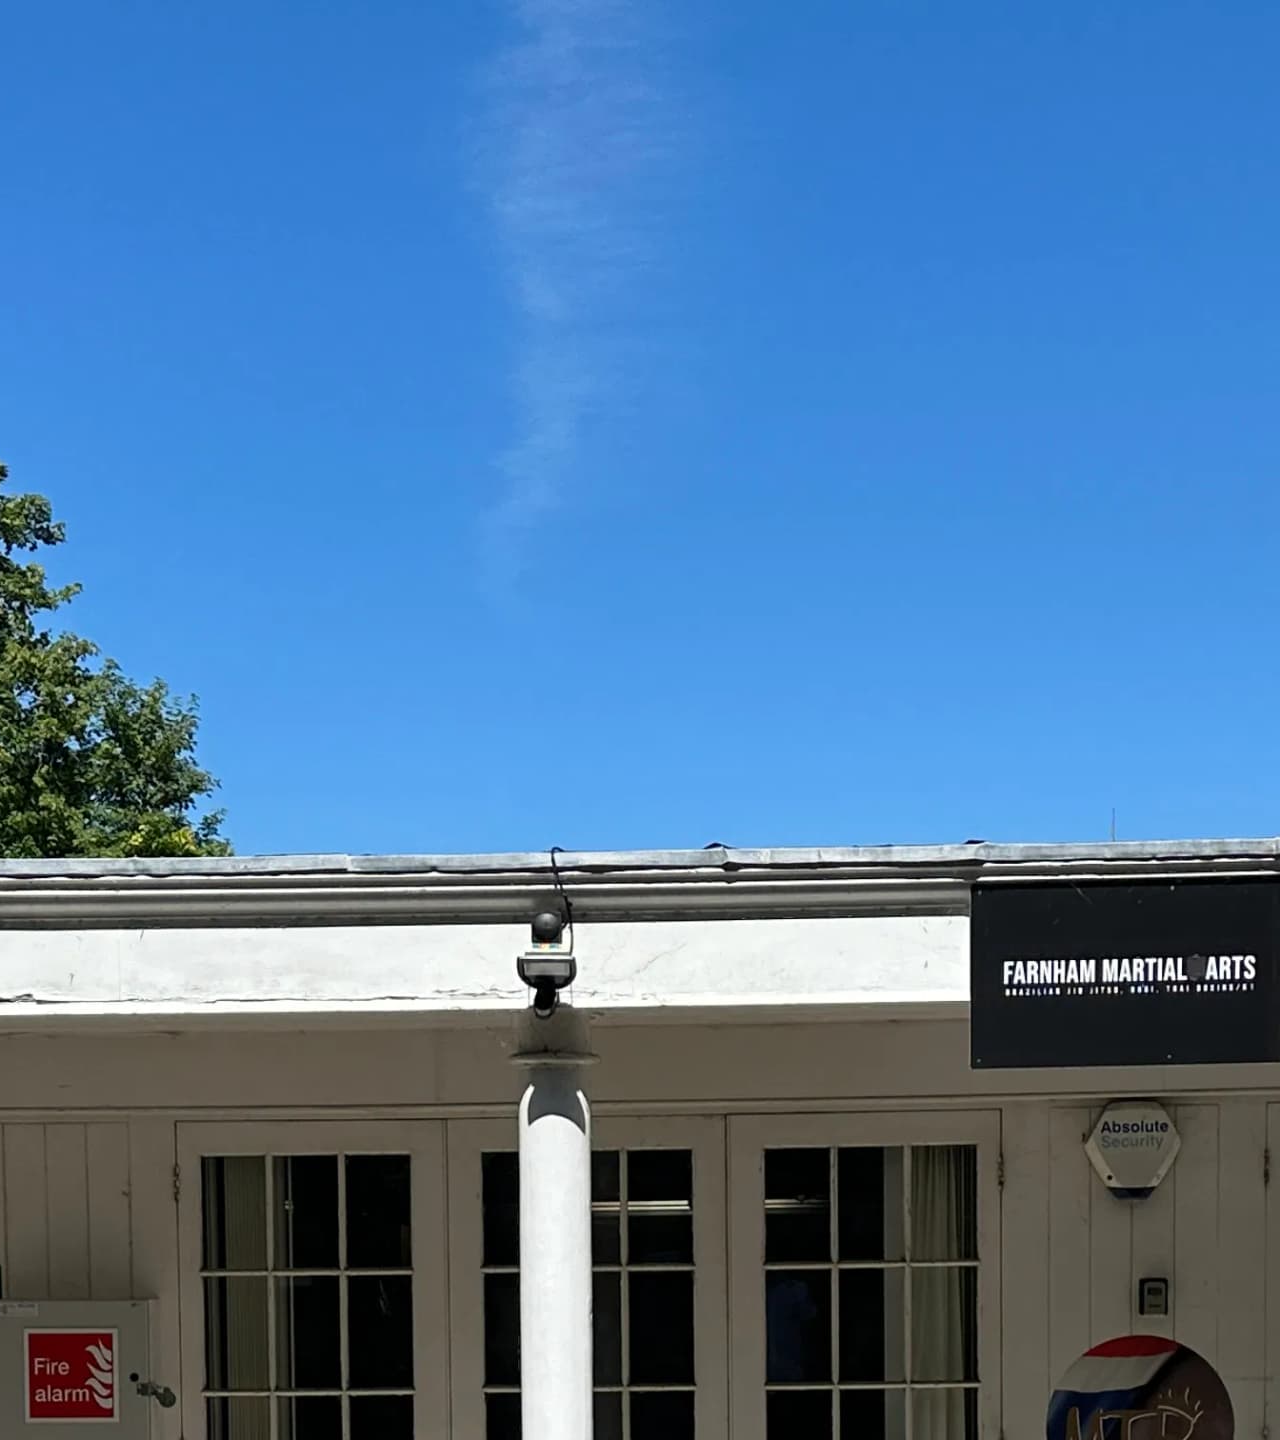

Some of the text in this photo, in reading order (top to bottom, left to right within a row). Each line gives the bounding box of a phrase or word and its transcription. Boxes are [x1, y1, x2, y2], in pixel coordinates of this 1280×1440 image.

[1003, 954, 1257, 985] FARNHAM MARTIAL ARTS
[1101, 1120, 1169, 1134] Absolute
[1102, 1135, 1164, 1150] Security
[34, 1358, 70, 1375] Fire
[35, 1385, 90, 1402] alarm
